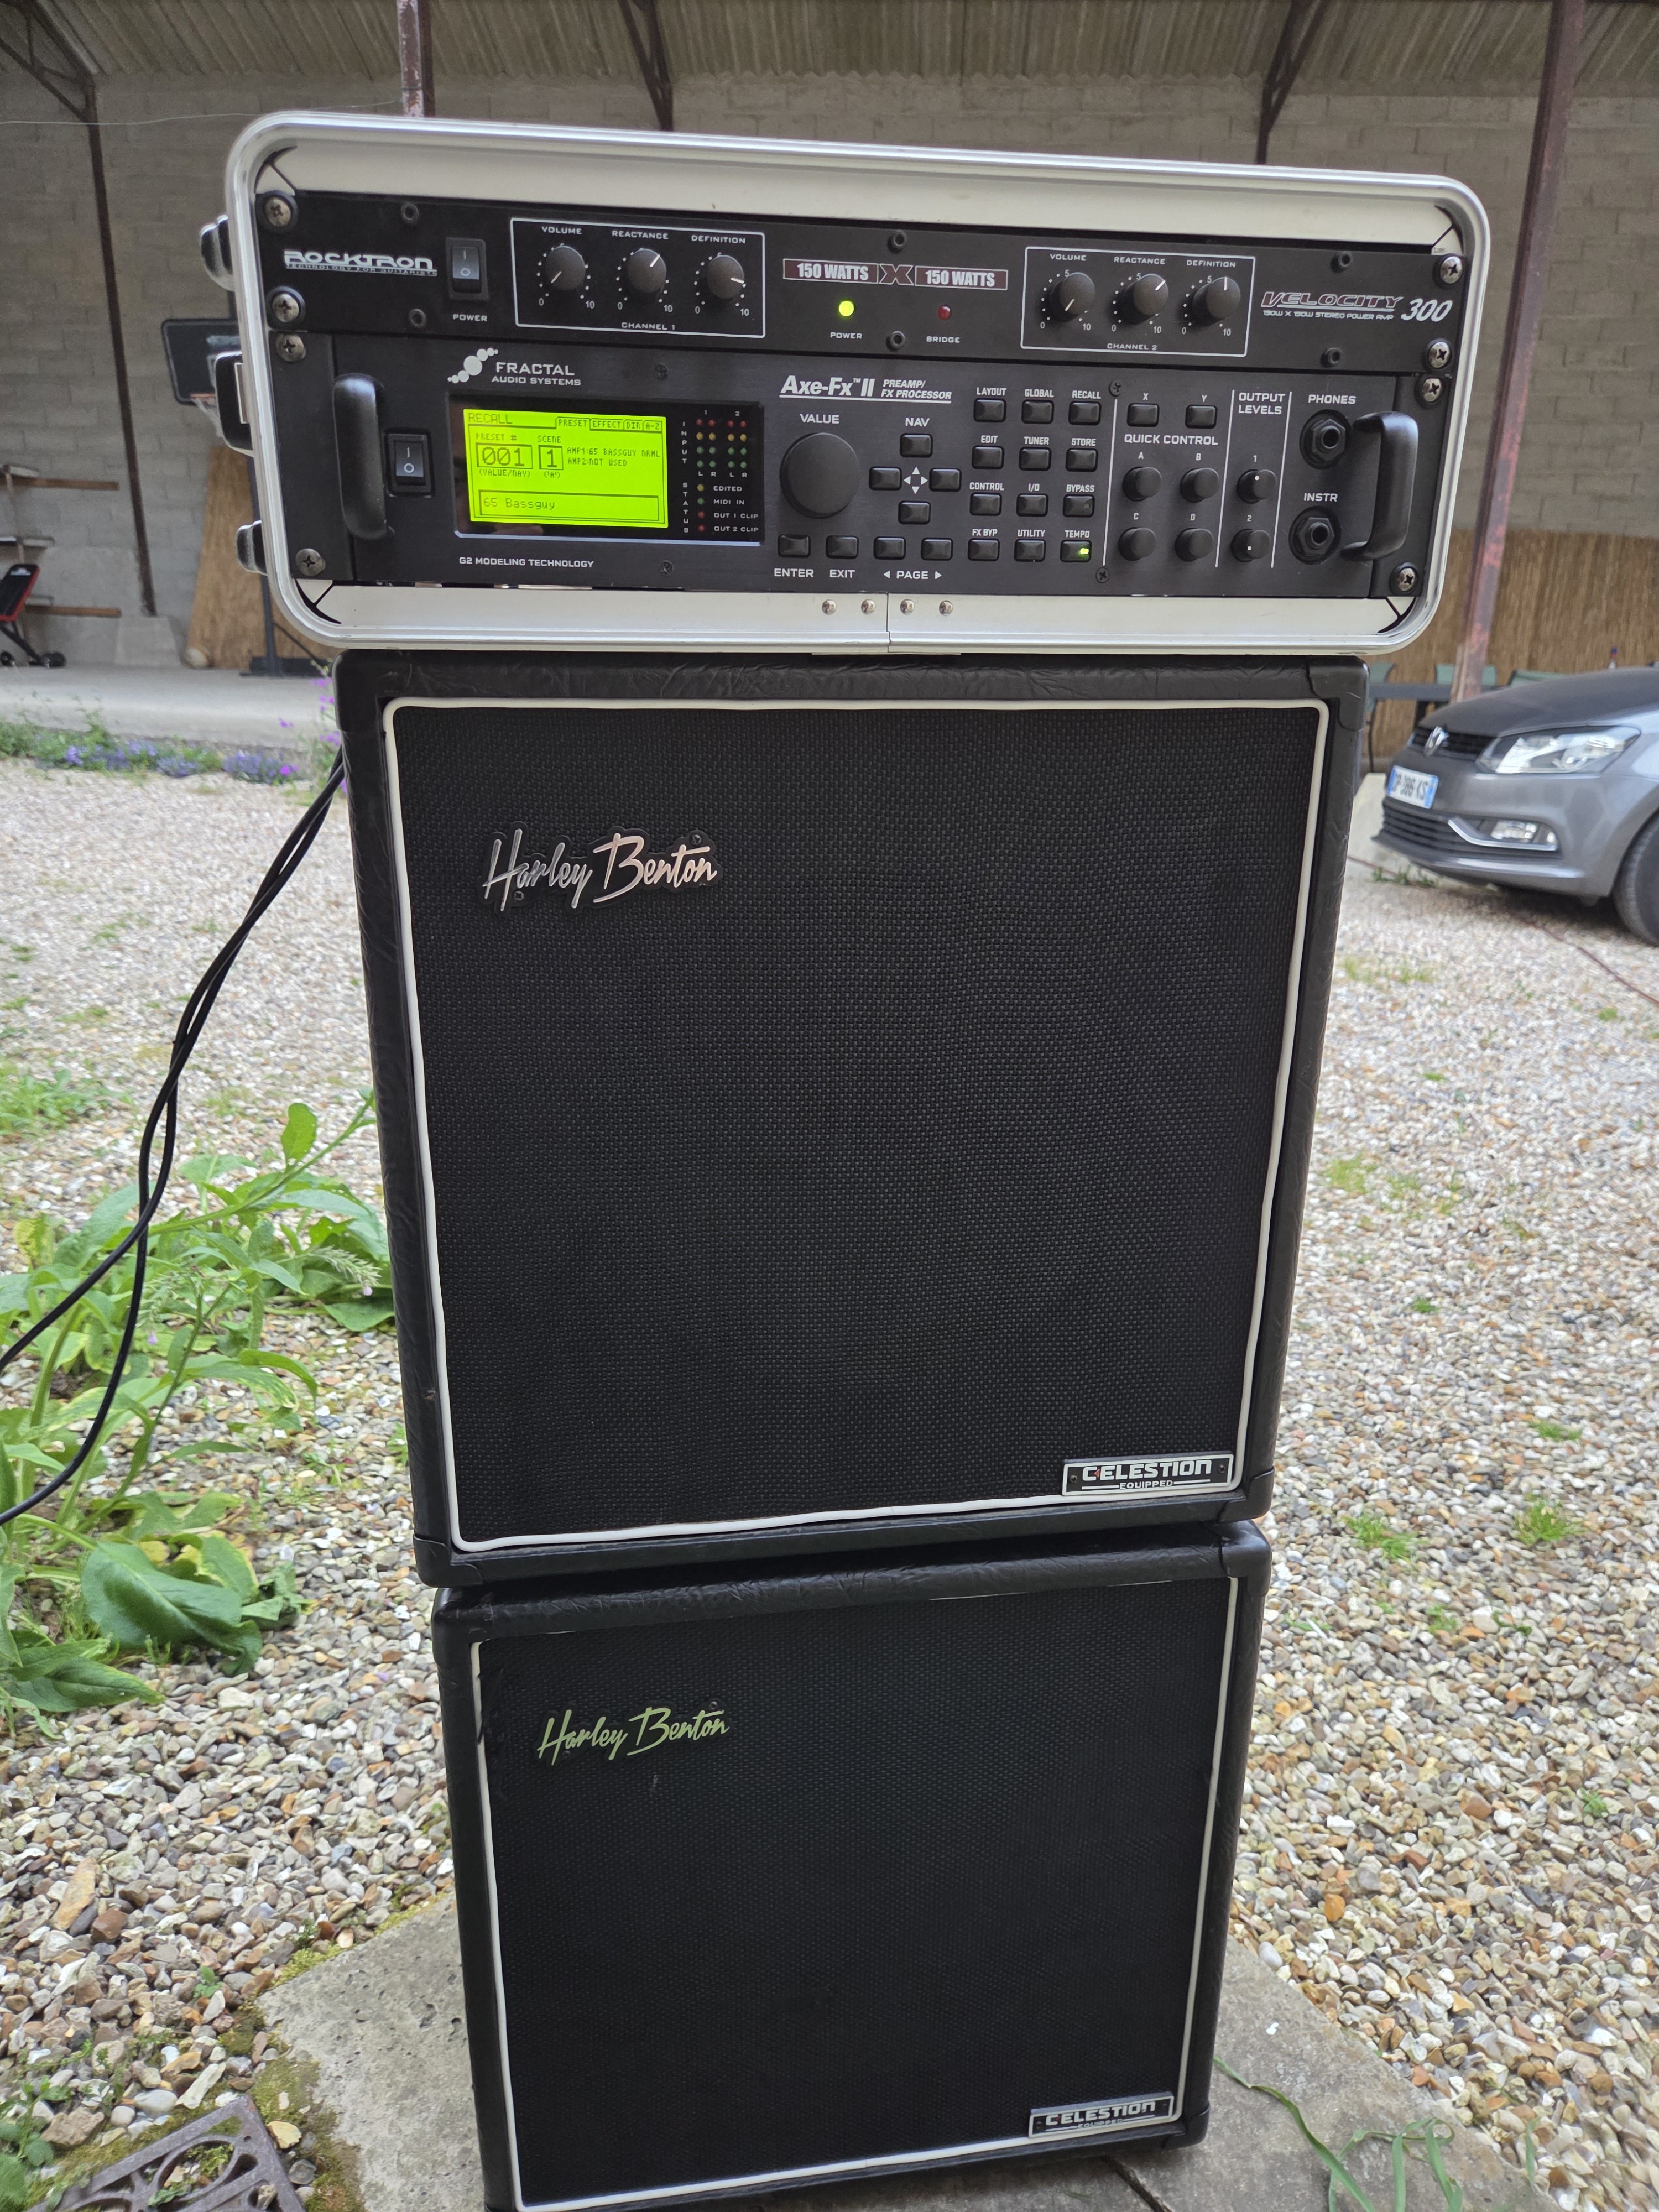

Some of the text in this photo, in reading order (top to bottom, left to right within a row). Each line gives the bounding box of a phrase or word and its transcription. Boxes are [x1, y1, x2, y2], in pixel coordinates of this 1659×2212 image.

[541, 226, 582, 235] VOLUME
[612, 230, 669, 240] REACTANCE
[691, 234, 746, 244] DEFINITION
[284, 251, 434, 270] ROCKTRON
[1114, 257, 1166, 265] REACTANCE
[1187, 259, 1236, 268] DEFINITION
[797, 263, 822, 278] 150
[824, 264, 869, 281] WATTS
[925, 270, 950, 285] 150
[951, 271, 995, 287] WATTS
[1207, 275, 1212, 284] 5
[538, 298, 545, 306] 0
[585, 300, 596, 310] 10
[617, 302, 623, 310] 0
[1261, 291, 1453, 322] VELOCITY 300
[664, 304, 674, 313] 10
[695, 306, 701, 315] 0
[740, 308, 750, 317] 10
[453, 314, 487, 322] POWER
[621, 321, 668, 331] CHANNEL
[1040, 321, 1045, 330] 0
[1111, 324, 1117, 332] 0
[1153, 326, 1162, 334] 10
[1181, 327, 1187, 335] 0
[830, 332, 863, 340] POWER
[1107, 342, 1149, 351] CHANNEL
[495, 362, 575, 376] FRACTAL
[491, 375, 581, 386] AUDIO SYSTEMS
[883, 379, 926, 389] PREAMP/
[881, 389, 952, 400] FX PROCESSOR
[977, 387, 1007, 396] LAYOUT
[1024, 389, 1054, 398] GLOBAL
[1072, 390, 1102, 399] RECALL
[1142, 393, 1149, 401] X
[1201, 394, 1207, 403] Y
[1239, 392, 1286, 402] OUTPUT
[1308, 394, 1357, 405] PHONES
[1238, 405, 1282, 415] LEVELS
[468, 413, 513, 425] RECALL
[559, 419, 587, 427] PRESET
[800, 413, 839, 424] VALUE
[905, 418, 930, 427] NAV
[592, 420, 621, 429] EFFECT
[627, 421, 641, 430] DIR
[476, 432, 505, 442] PRESET
[537, 435, 561, 444] SCENE
[980, 435, 998, 444] EDIT
[1024, 436, 1050, 445] TUNER
[1071, 437, 1096, 446] STORE
[1124, 434, 1218, 445] QUICK CONTROL
[482, 446, 525, 467] 001
[603, 448, 637, 457] BASSGUY
[1138, 451, 1144, 460] A
[546, 448, 558, 468] 1
[608, 458, 627, 467] USED
[969, 482, 1004, 491] CONTROL
[1028, 483, 1040, 492] I/O
[1066, 484, 1095, 493] BYPASS
[1303, 492, 1338, 502] INSTR
[483, 497, 555, 510] 65 Bassguy
[972, 528, 982, 536] FX
[1017, 529, 1045, 538] UTILITY
[1065, 530, 1090, 538] TEMPO
[475, 557, 525, 566] MODELING
[528, 559, 594, 568] TECHNOLOGY
[774, 568, 814, 578] ENTER
[830, 569, 855, 578] EXIT
[896, 571, 928, 580] PAGE
[482, 828, 718, 911] Harley Benton
[1082, 1459, 1212, 1481] CELESTION
[1119, 1480, 1173, 1489] EQUIPPED
[537, 1707, 730, 1766] Harley Benton
[1045, 2101, 1156, 2126] CELESTION
[1077, 2118, 1124, 2129] EQUIPPED
